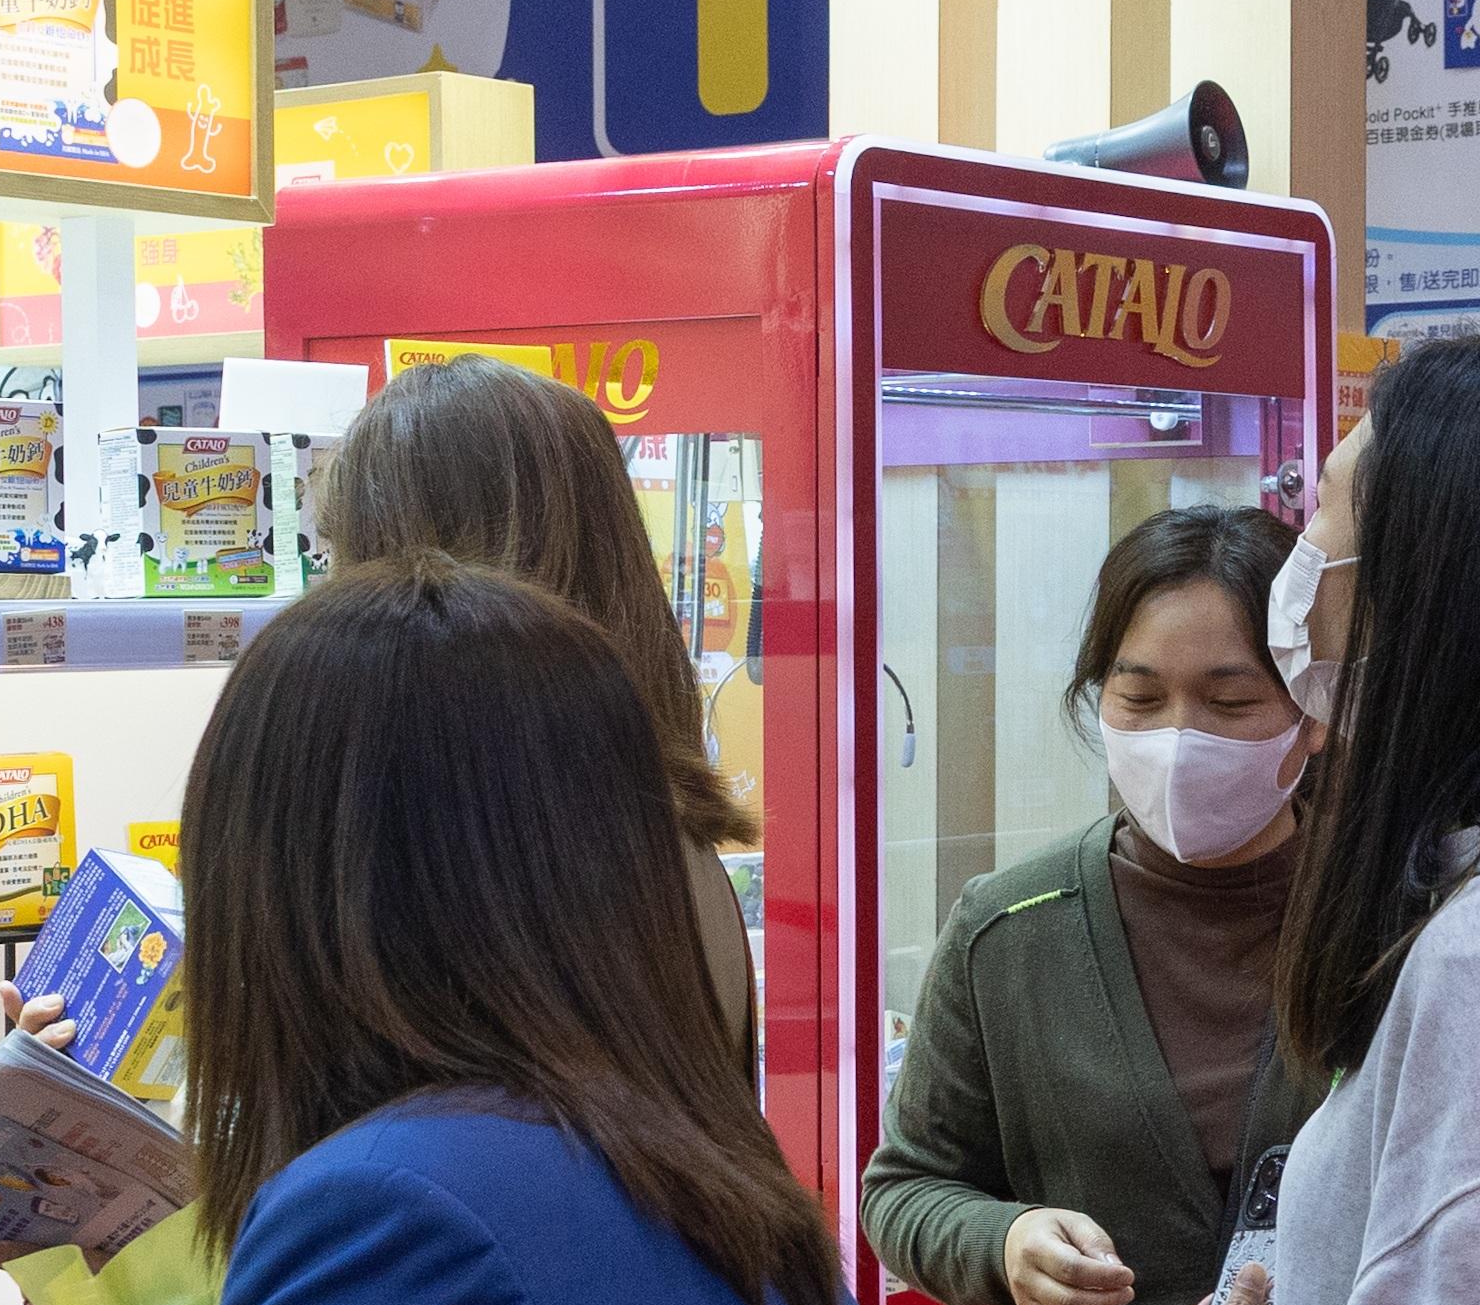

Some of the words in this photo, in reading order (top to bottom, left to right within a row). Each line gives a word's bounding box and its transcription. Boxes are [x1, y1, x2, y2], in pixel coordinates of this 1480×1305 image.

[129, 35, 196, 83] 成長
[141, 238, 179, 266] 強身
[978, 243, 1233, 368] CATALO
[399, 351, 446, 366] CATALO
[187, 438, 226, 452] CATALO
[184, 455, 231, 474] Children's
[162, 468, 255, 503] 兒童牛奶鈣
